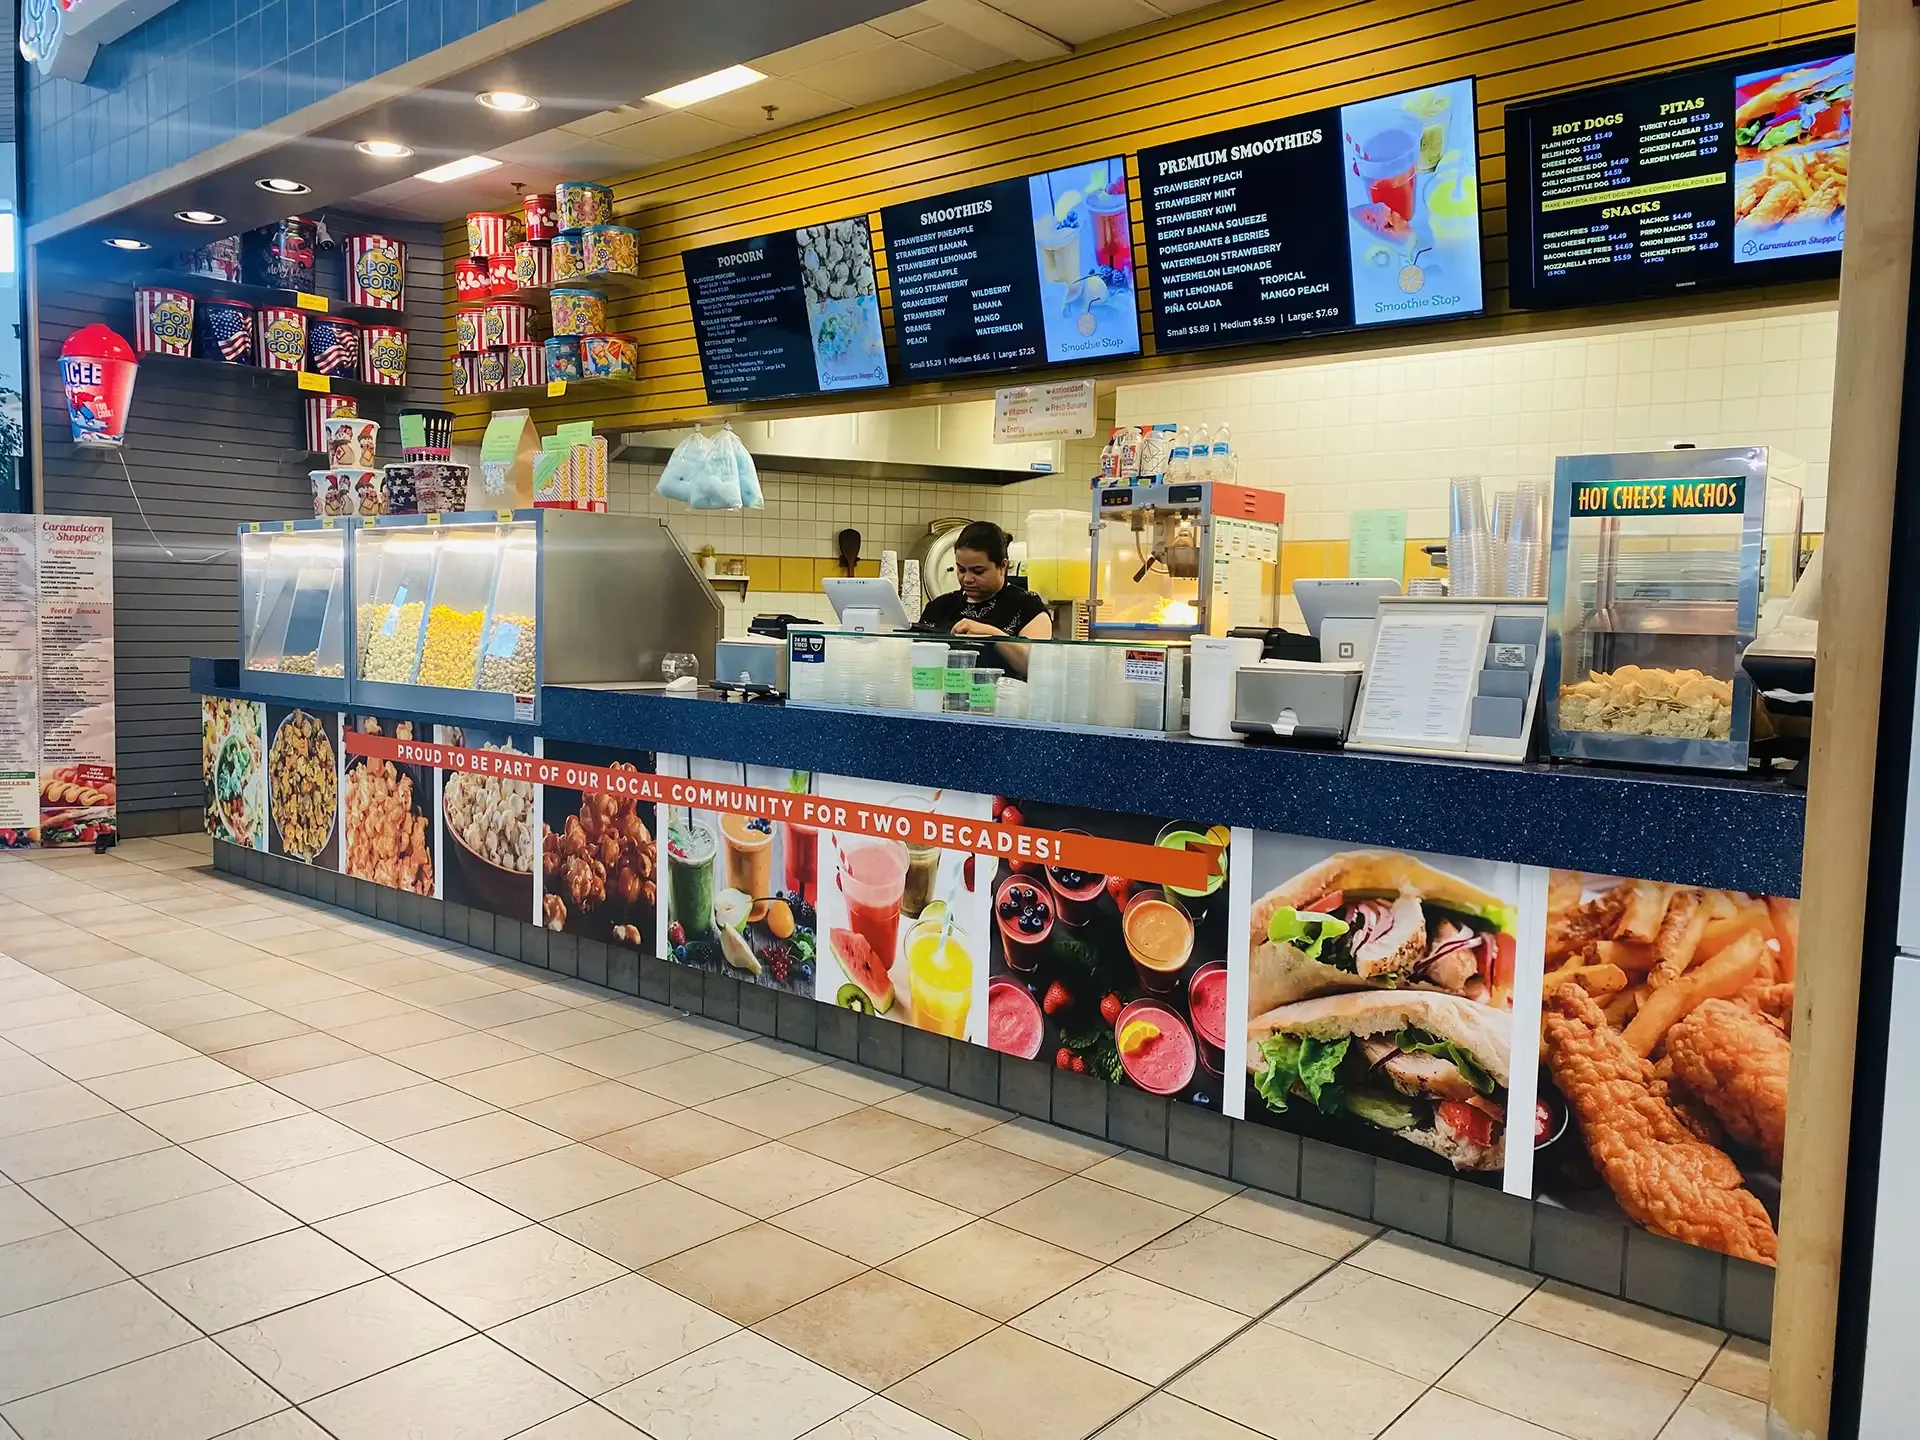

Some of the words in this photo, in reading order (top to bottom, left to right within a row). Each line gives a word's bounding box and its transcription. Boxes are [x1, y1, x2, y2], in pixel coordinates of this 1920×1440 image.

[1660, 97, 1705, 115] PITAS
[1552, 122, 1580, 136] HOT
[1584, 113, 1624, 130] DOGS
[1639, 121, 1667, 132] TURKEY
[1669, 117, 1688, 126] CLUB
[1690, 113, 1710, 122] $5.39
[1542, 141, 1560, 150] PLAIN
[1594, 131, 1613, 140] $3.49
[1639, 132, 1670, 143] CHICKEN
[1672, 126, 1701, 137] CAESAR
[1704, 122, 1724, 131] $5.39
[1158, 149, 1227, 176] PREMIUM
[1231, 128, 1322, 161] SMOOTHIES
[1640, 144, 1670, 154] CHICKEN
[1672, 139, 1696, 148] FAJITA
[1699, 135, 1719, 144] $5.39
[1542, 150, 1564, 159] RELISH
[1640, 155, 1670, 166] GARDEN
[1671, 150, 1697, 160] VEGGIE
[1542, 159, 1566, 169] CHEESE
[1542, 169, 1565, 178] BACON
[1566, 164, 1591, 174] CHEESE
[1593, 160, 1607, 169] DOG
[1610, 157, 1629, 166] $4.69
[1153, 177, 1211, 196] STRAWBERRY
[1213, 170, 1243, 184] PEACH
[1542, 179, 1559, 188] CHILI
[1560, 175, 1585, 184] CHEESE
[1604, 168, 1622, 177] $4.59
[1542, 187, 1571, 197] CHICAGO
[1573, 183, 1593, 192] STYLE
[1612, 177, 1630, 186] $5.09
[1155, 192, 1212, 211] STRAWBERRY
[1214, 188, 1236, 199] MINT
[920, 200, 993, 226] SMOOTHIES
[1156, 208, 1213, 226] STRAWBERRY
[1216, 203, 1236, 214] KIWI
[1602, 200, 1661, 219] SNACKS
[1158, 228, 1185, 241] BERRY
[1187, 223, 1224, 235] BANANA
[1226, 213, 1267, 229] SQUEEZE
[1640, 216, 1670, 226] NACHOS
[1672, 212, 1692, 220] $4.49
[894, 232, 936, 247] STRAWBERRY
[937, 225, 974, 239] PINEAPPLE
[1543, 230, 1569, 240] FRENCH
[1640, 227, 1662, 236] PRIMO
[1663, 223, 1693, 233] NACHOS
[1696, 220, 1716, 229] $5.69
[1159, 238, 1223, 255] POMEGRANATE
[1232, 229, 1270, 243] BERRIES
[1544, 241, 1560, 250] CHILI
[1561, 238, 1586, 248] CHEESE
[1587, 236, 1606, 244] FRIES
[1608, 233, 1626, 241] $4.49
[1640, 238, 1663, 247] ONION
[1664, 235, 1686, 244] RINGS
[1689, 232, 1708, 241] $3.29
[1759, 240, 1806, 251] Caramelcorn
[1808, 236, 1836, 244] Shoppe
[717, 249, 764, 268] POPCORN
[895, 245, 938, 260] STRAWBERRY
[939, 240, 968, 251] BANANA
[1161, 254, 1219, 270] WATERMELON
[1221, 243, 1282, 260] STRAWBERRY
[1544, 251, 1566, 260] BACON
[1567, 248, 1592, 258] CHEESE
[1615, 243, 1633, 251] $4.69
[1640, 248, 1670, 258] CHICKEN
[1671, 245, 1696, 254] STRIPS
[1699, 242, 1718, 251] $6.89
[366, 260, 398, 275] POP
[897, 258, 939, 272] STRAWBERRY
[941, 251, 978, 264] LEMONADE
[1544, 261, 1587, 271] MOZZARELLA
[899, 275, 922, 284] MANGO
[923, 268, 958, 280] PINEAPPLE
[1162, 269, 1220, 285] WATERMELON
[1222, 260, 1272, 275] LEMONADE
[1260, 271, 1306, 285] TROPICAL
[359, 274, 401, 291] CORN
[900, 287, 924, 296] MANGO
[925, 279, 968, 293] STRAWBERRY
[1163, 289, 1184, 299] MINT
[1185, 282, 1233, 296] LEMONADE
[971, 285, 1011, 298] WILDBERRY
[1261, 288, 1295, 300] MANGO
[1298, 283, 1329, 295] PEACH
[902, 295, 948, 308] ORANGEBERRY
[973, 300, 1002, 311] BANANA
[1165, 301, 1185, 314] PIÑA
[1187, 299, 1222, 311] COLADA
[1375, 298, 1429, 313] Smoothie
[1431, 294, 1460, 306] Stop
[161, 310, 189, 325] POP
[904, 308, 946, 321] STRAWBERRY
[975, 313, 1000, 323] MANGO
[1167, 328, 1187, 337] Small
[1188, 325, 1209, 335] $5.89
[1220, 320, 1251, 330] Medium
[1253, 316, 1275, 326] $6.59
[1288, 312, 1314, 322] Large:
[1316, 308, 1338, 318] $7.69
[154, 324, 192, 340] CORN
[274, 329, 302, 342] POP
[905, 323, 932, 333] ORANGE
[976, 323, 1023, 336] WATERMELON
[268, 341, 304, 354] CORN
[907, 336, 928, 345] PEACH
[1061, 340, 1100, 352] Smoothie
[1102, 338, 1123, 347] Stop
[378, 347, 403, 358] POP
[949, 356, 972, 364] Medium
[973, 353, 990, 362] $6.45
[998, 350, 1017, 359] Large:
[1018, 347, 1035, 356] $7.25
[373, 358, 405, 370] CORN
[65, 361, 102, 386] ICEE
[1579, 487, 1609, 510] HOT
[1613, 484, 1667, 509] CHEESE
[1672, 482, 1737, 508] NACHOS
[42, 522, 104, 533] Caramelcorn
[56, 532, 91, 543] Shoppe
[397, 744, 441, 764] PROUD
[448, 752, 464, 767] TO
[472, 755, 487, 770] BE
[495, 759, 532, 778] PART
[539, 766, 560, 781] OF
[567, 771, 599, 788] OUR
[607, 775, 663, 798] LOCAL
[672, 784, 793, 817] COMMUNITY
[803, 803, 847, 826] FOR
[857, 811, 911, 836] TWO
[923, 820, 1061, 861] DECADES!
